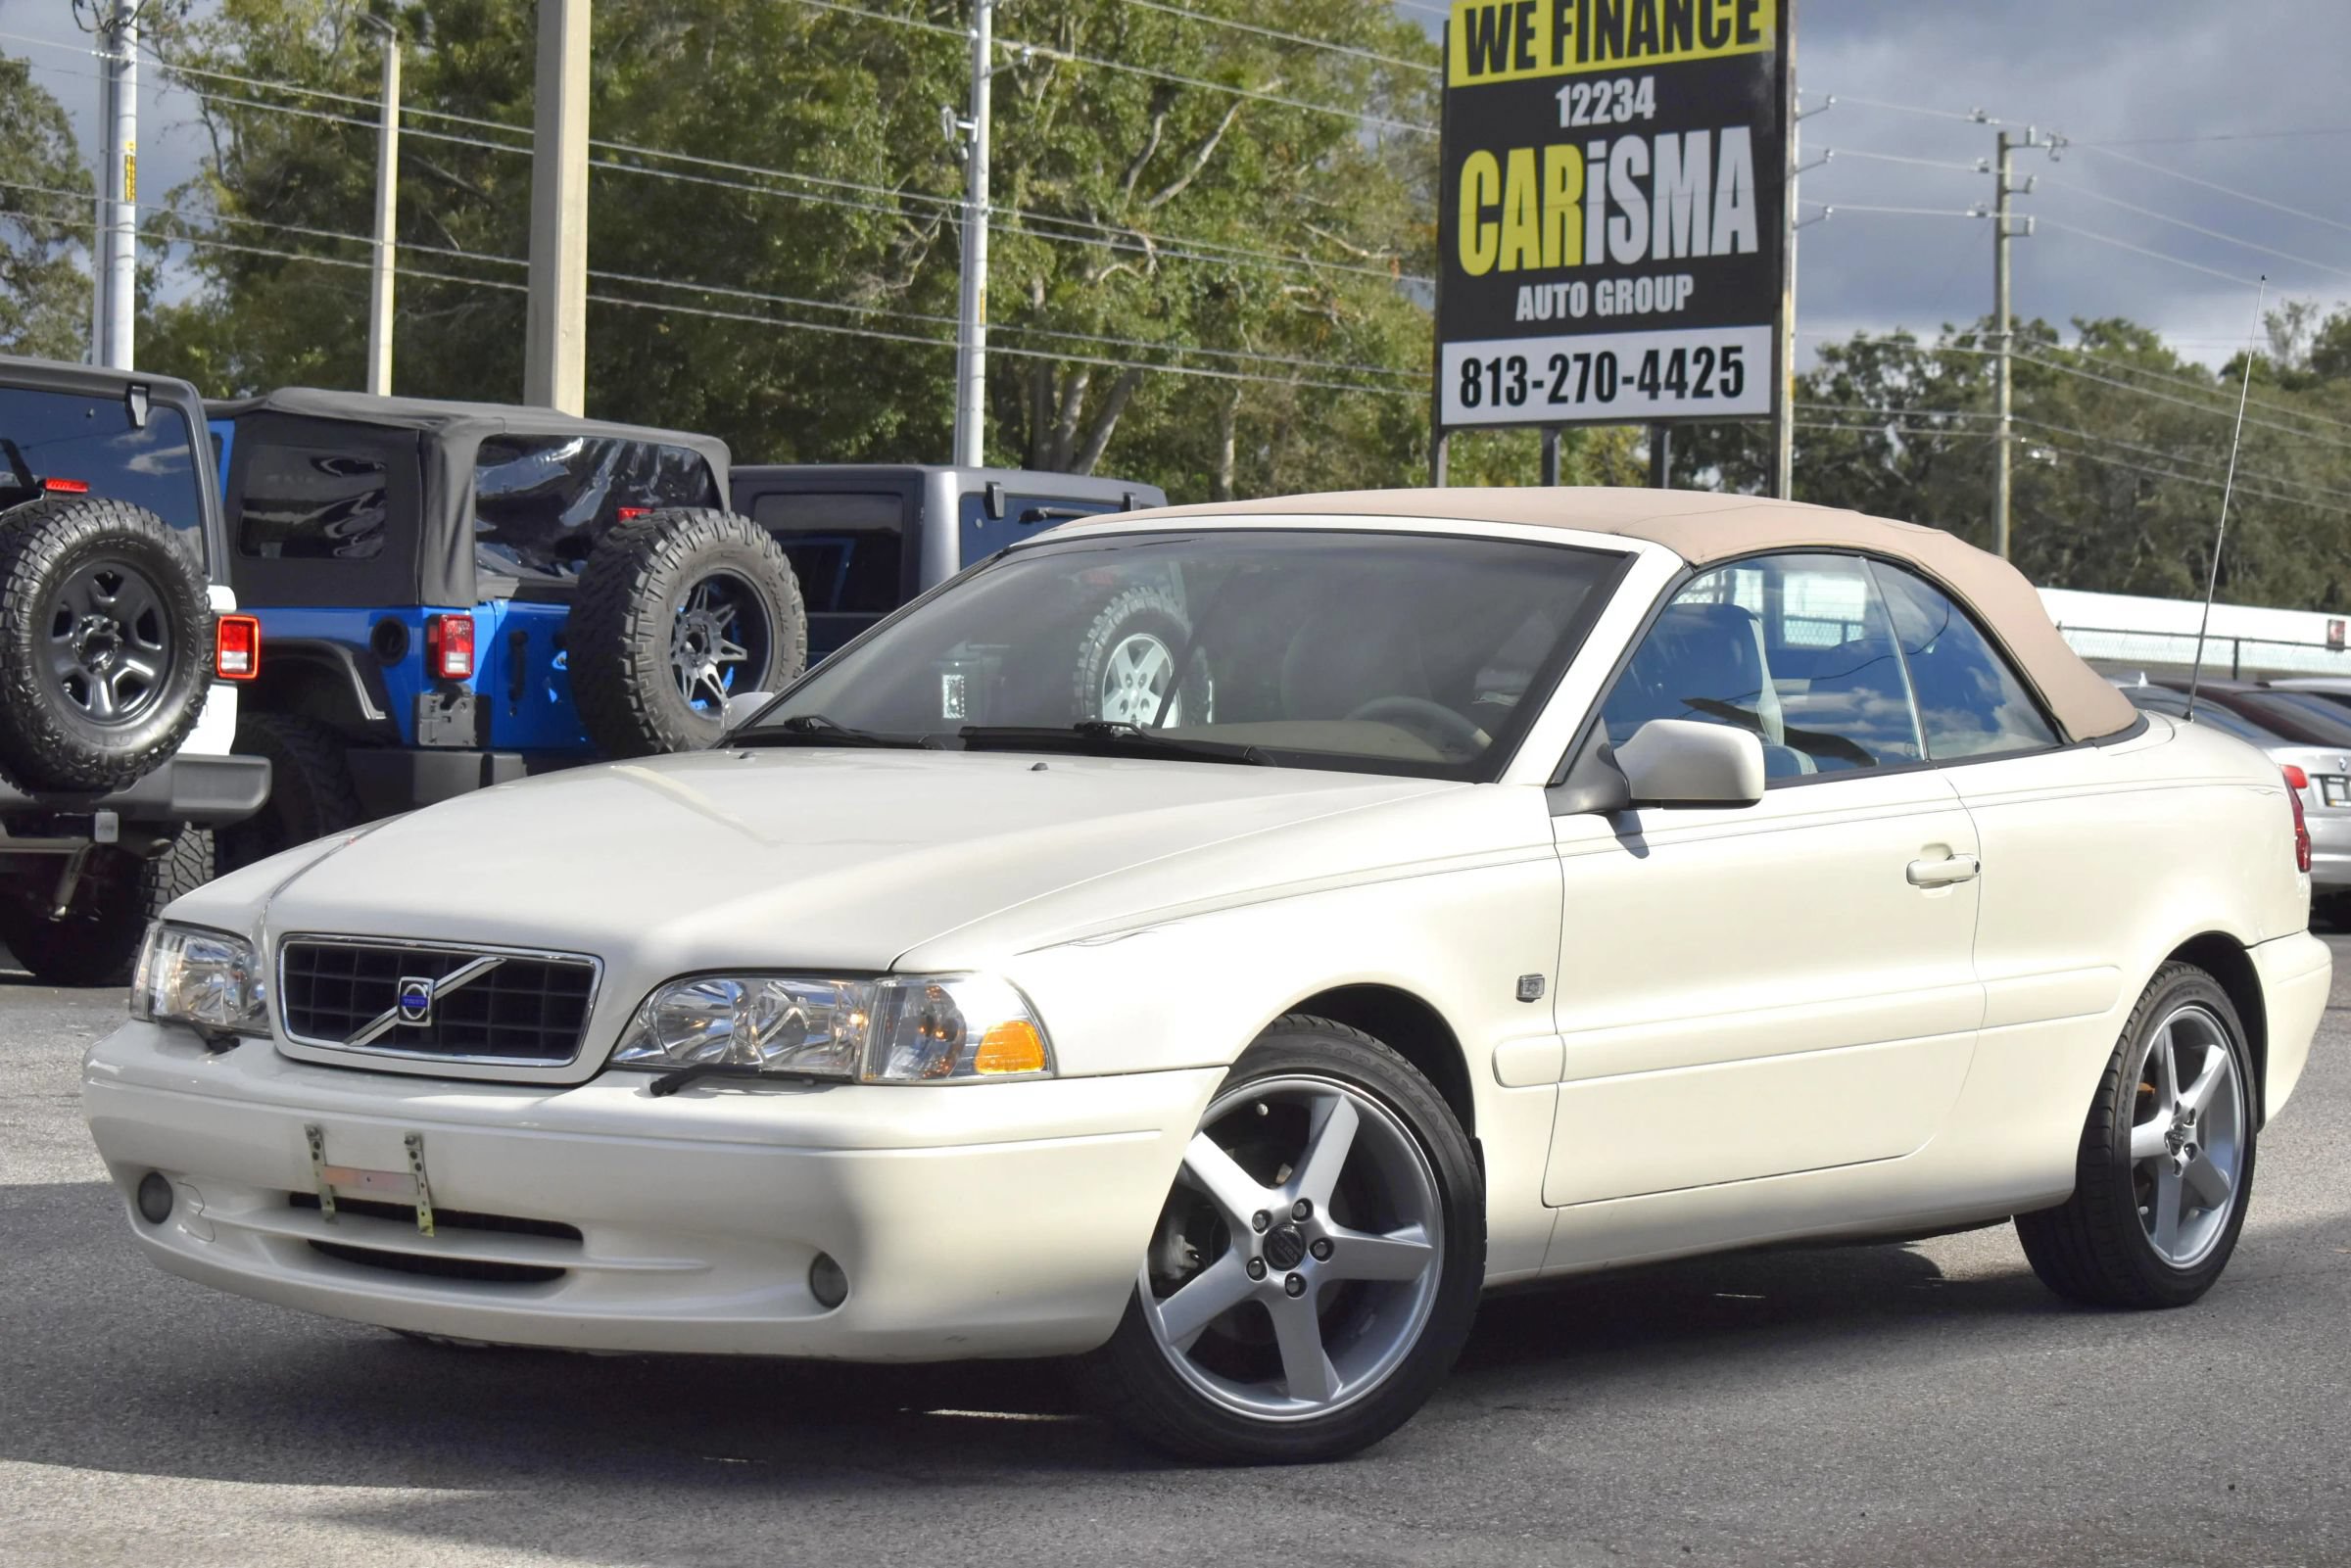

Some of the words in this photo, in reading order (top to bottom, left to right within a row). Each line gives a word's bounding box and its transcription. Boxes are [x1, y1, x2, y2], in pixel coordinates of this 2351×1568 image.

[1464, 0, 1537, 76] WE
[1551, 0, 1761, 67] FINANCE
[1555, 75, 1656, 128] 12234
[1514, 281, 1589, 322] AUTO
[1595, 273, 1695, 317] GROUP
[1459, 345, 1746, 409] 813-270-4425
